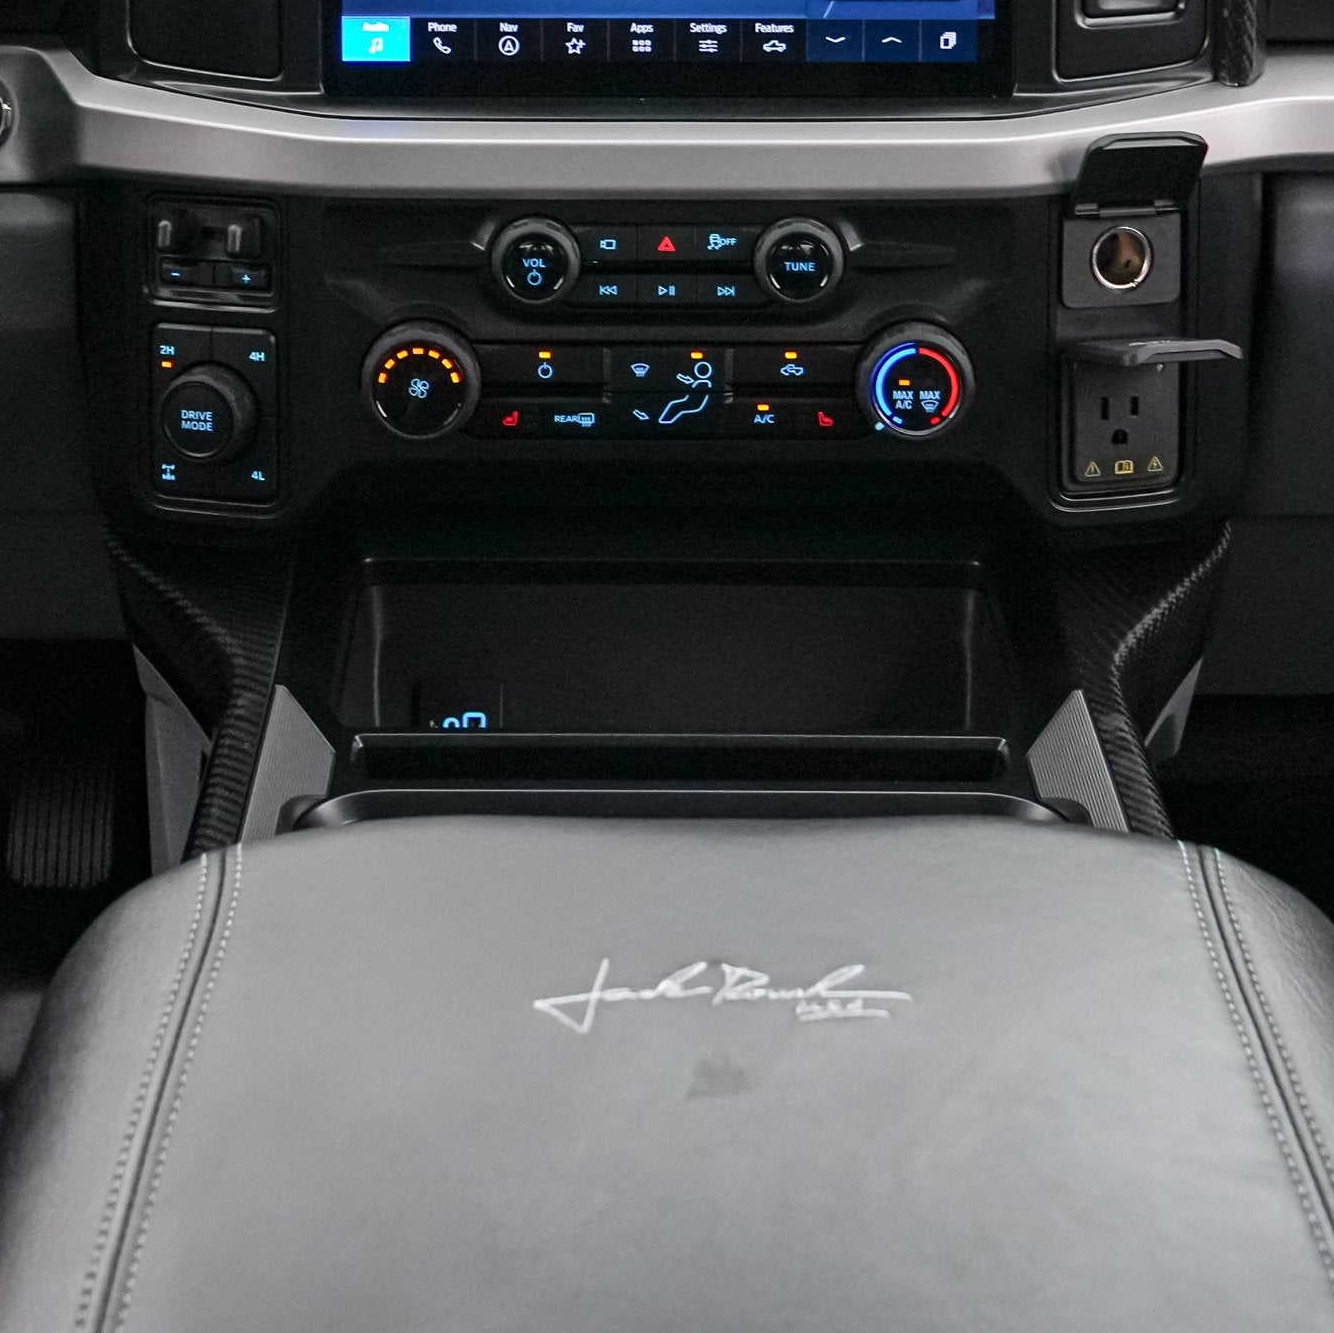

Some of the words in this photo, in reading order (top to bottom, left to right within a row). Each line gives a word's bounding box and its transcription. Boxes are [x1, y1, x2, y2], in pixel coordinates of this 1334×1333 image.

[427, 22, 458, 33] Phone
[499, 22, 519, 33] Nav
[566, 22, 584, 33] Fav
[629, 22, 654, 35] Apps
[689, 22, 728, 35] Settings
[754, 22, 795, 34] Features
[720, 237, 737, 247] OFF
[522, 257, 546, 269] VOL
[784, 260, 816, 272] TUNE
[159, 345, 175, 356] 2H
[248, 351, 266, 362] 4H
[892, 390, 914, 400] MAX
[919, 390, 941, 400] MAX
[895, 400, 913, 410] A/C
[180, 409, 213, 421] DRIVE
[554, 415, 578, 423] REAR
[754, 413, 775, 425] A/C
[180, 420, 214, 432] MODE
[250, 471, 266, 481] 4L
